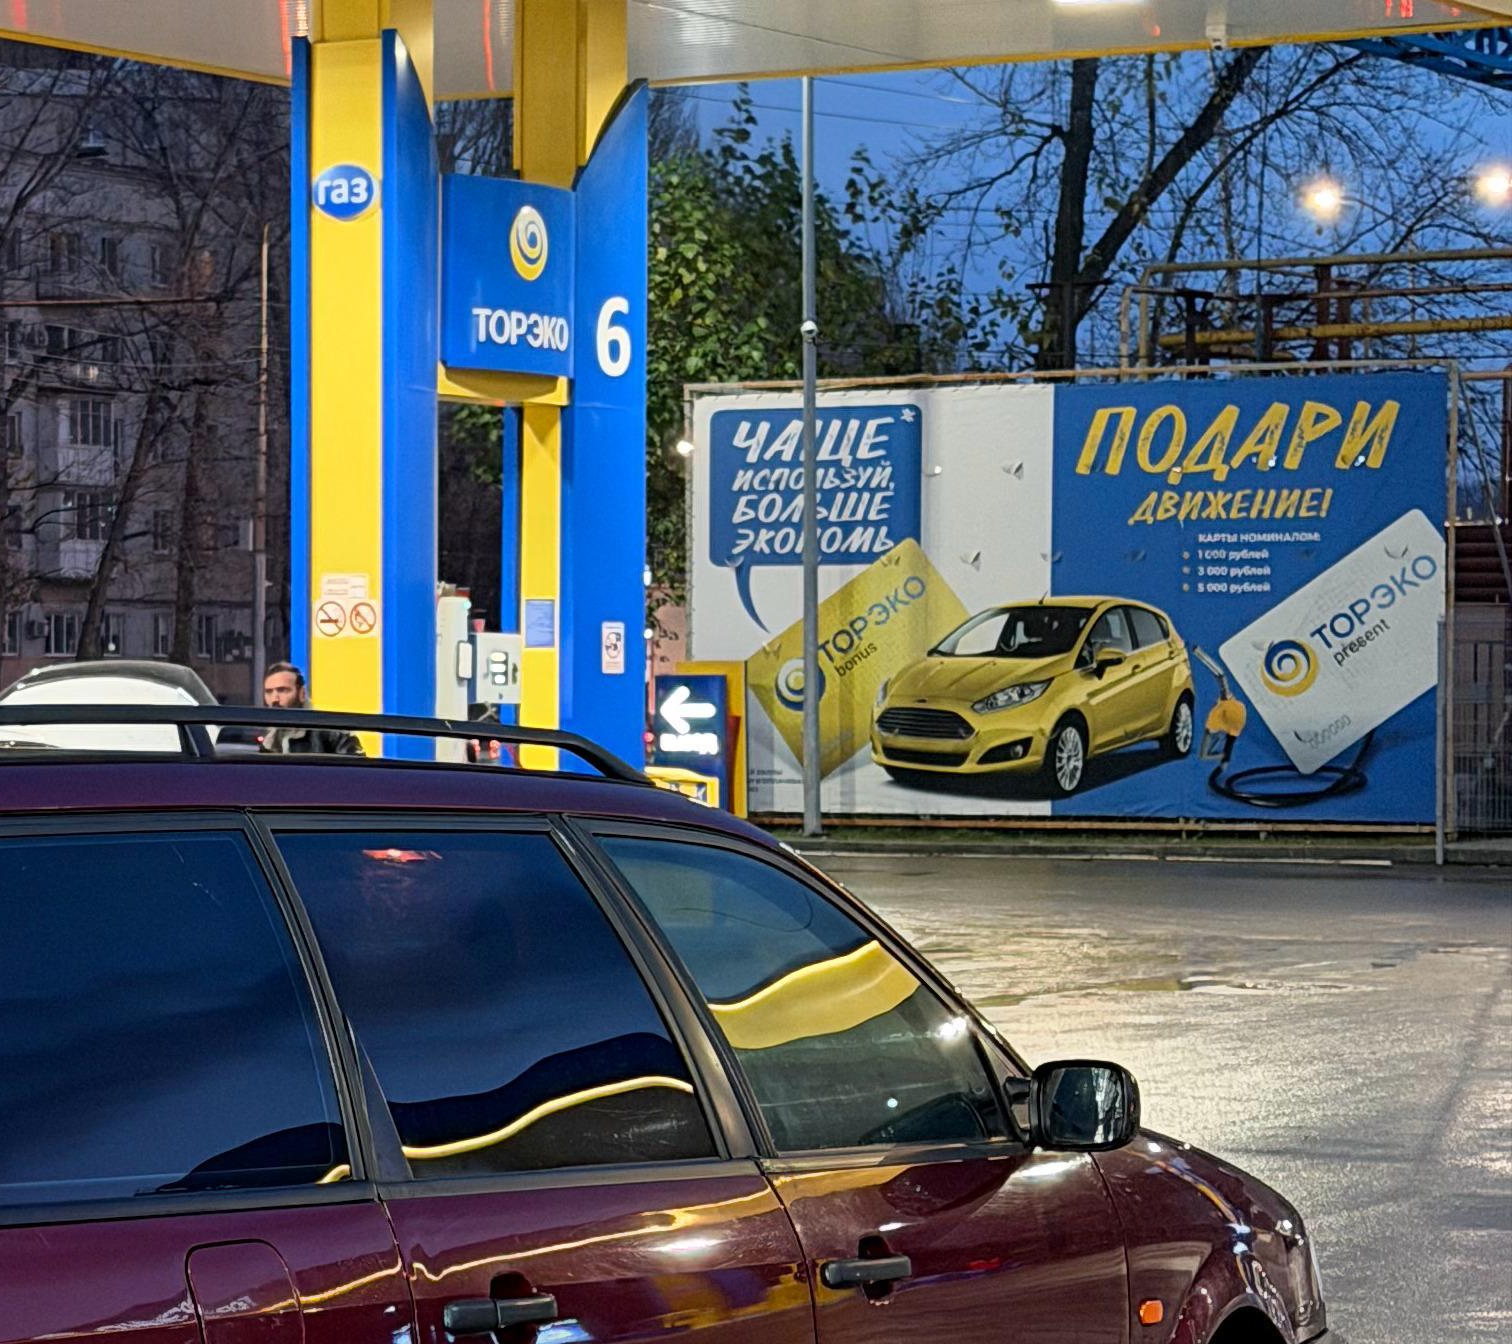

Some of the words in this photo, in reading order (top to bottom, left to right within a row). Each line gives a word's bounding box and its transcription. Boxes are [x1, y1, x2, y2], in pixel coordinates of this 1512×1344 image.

[317, 176, 369, 206] газ
[471, 307, 569, 352] ТОРЭКО
[596, 296, 632, 378] 6
[1075, 399, 1400, 486] ПОДАРИ
[1126, 487, 1334, 527] ДВИЖЕНИЕ!
[817, 575, 926, 665] ТОРЭКО
[1309, 554, 1437, 650] ТОРЭКО
[834, 641, 878, 678] bonus
[1332, 618, 1391, 667] present
